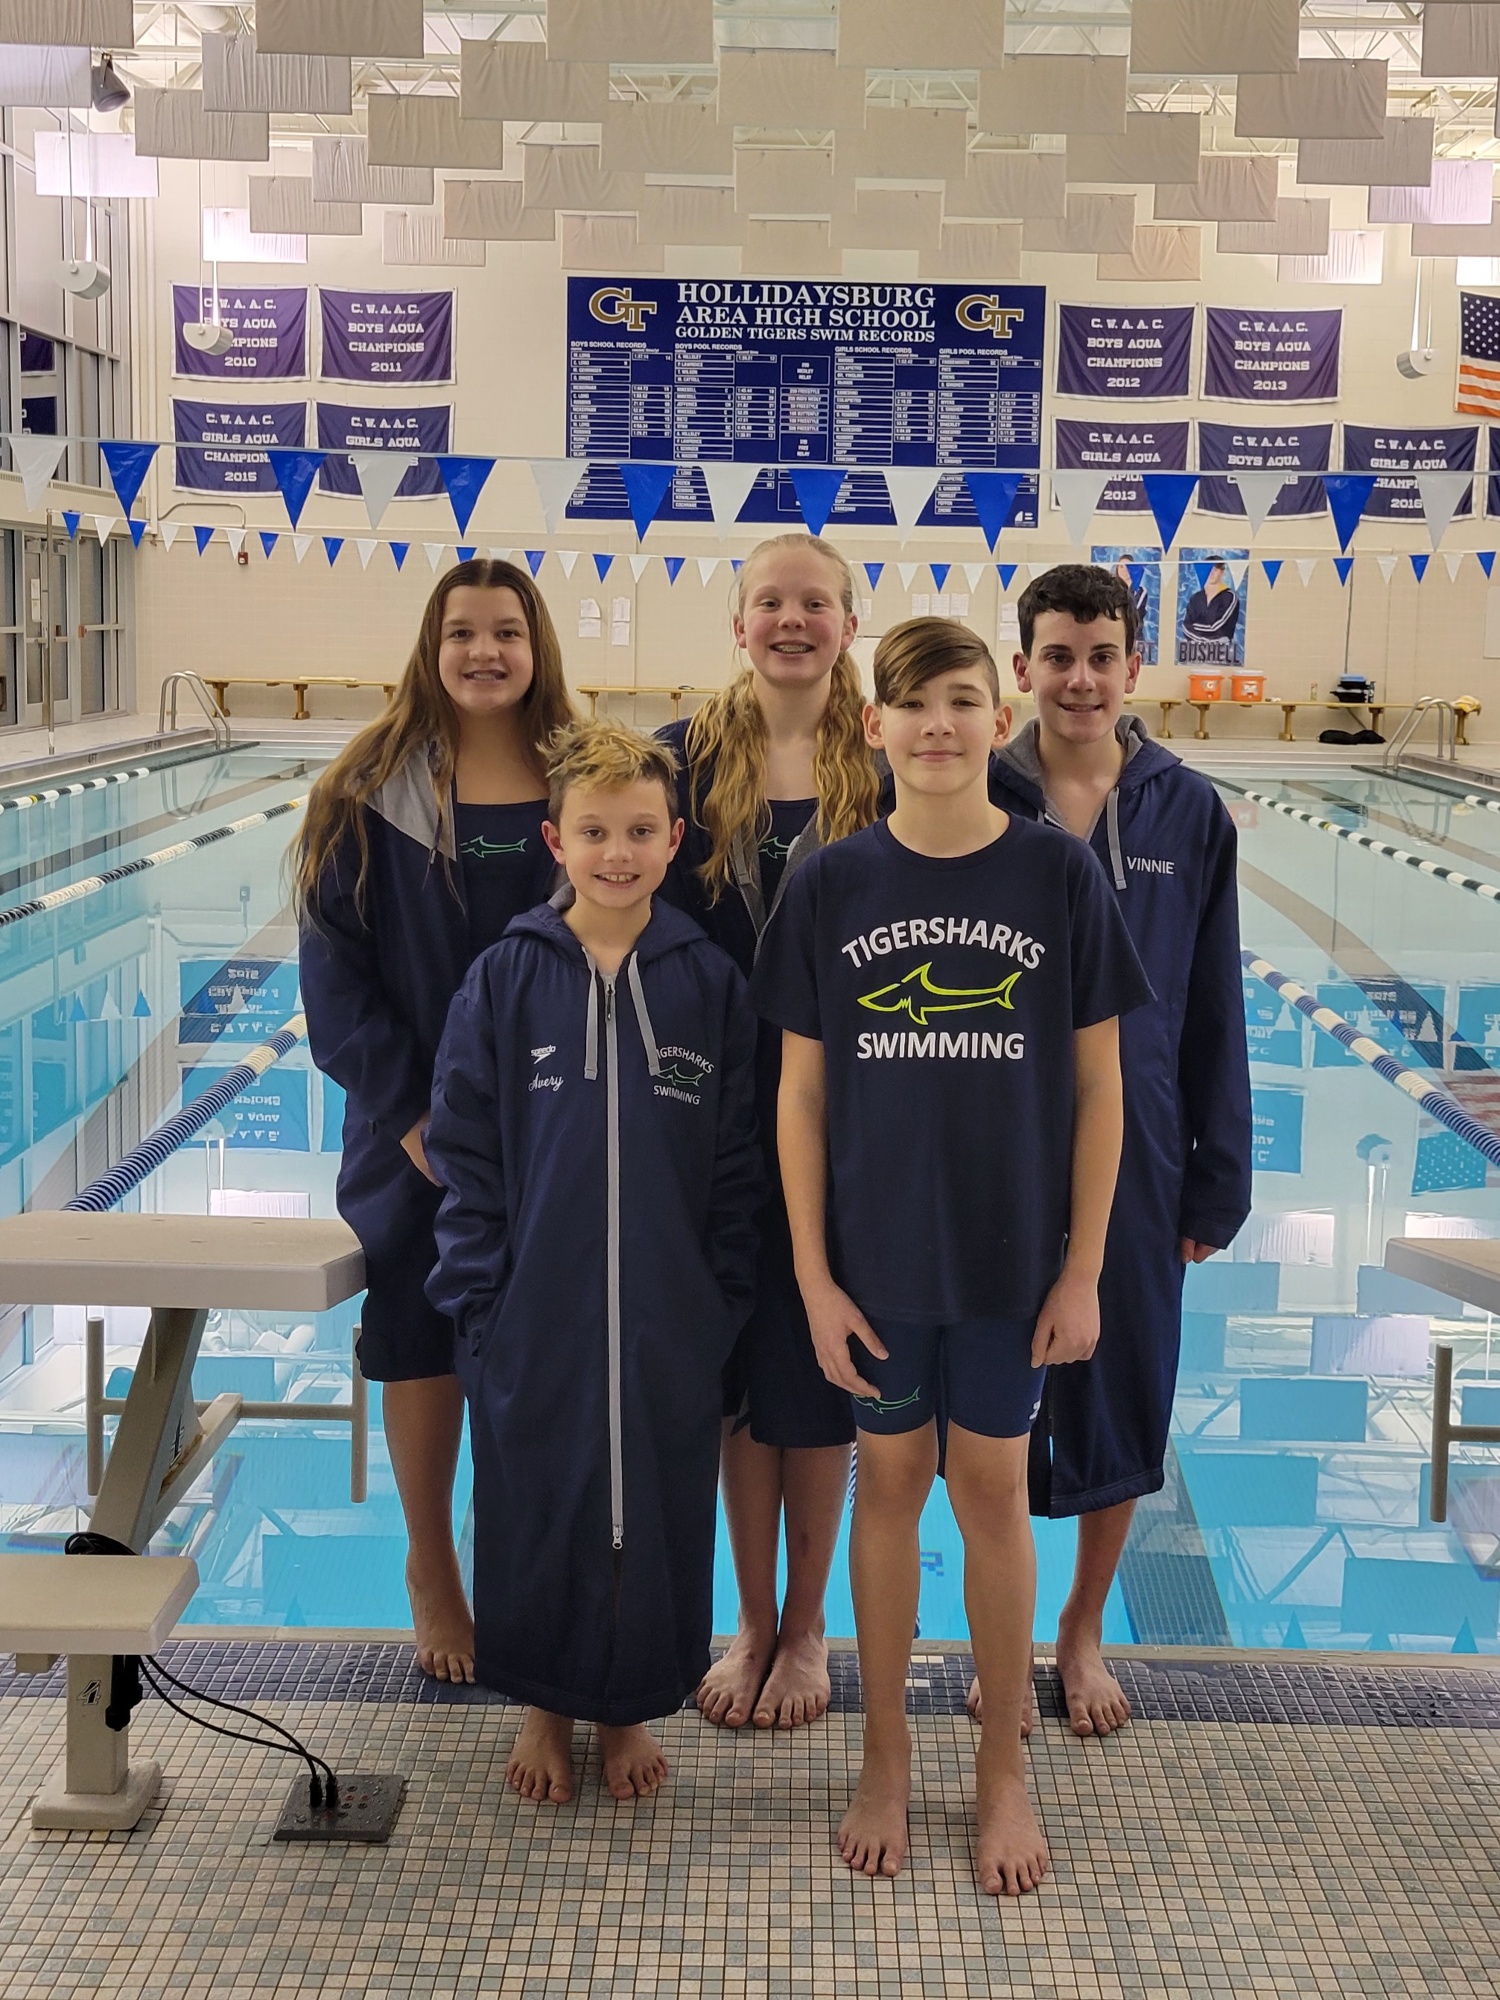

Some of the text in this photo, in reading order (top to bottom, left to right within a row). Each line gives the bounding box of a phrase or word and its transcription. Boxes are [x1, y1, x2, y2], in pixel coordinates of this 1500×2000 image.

[677, 282, 936, 308] HOLLIDAYSBURG
[204, 317, 276, 329] BYS AQUA
[676, 306, 936, 328] AREA HIGH SCHOOL
[348, 323, 424, 334] BOYS AQUA
[675, 327, 935, 342] GOLDEN TIGERS SWIM RECORDS
[349, 342, 424, 352] CHAMPIONS
[1087, 338, 1162, 349] BOYS AQUA
[1234, 340, 1311, 352] BOYS AQUA
[225, 357, 256, 367] 2010
[371, 362, 402, 372] 2011
[1087, 357, 1163, 368] CHAMPIONS
[1234, 360, 1310, 371] CHAMPIONS
[1107, 378, 1140, 387] 2012
[1253, 381, 1287, 390] 2013
[202, 432, 279, 444] GIRLS AQUA
[346, 435, 421, 447] GIRLS AQUA
[204, 451, 270, 463] CHAMPION
[1081, 451, 1161, 463] GIRLS AQUA
[1227, 455, 1300, 466] BOYS AQUA
[1370, 458, 1447, 470] GIRLS AQUA
[224, 472, 257, 482] 2015
[1103, 491, 1136, 500] 2013
[1390, 499, 1423, 508] 2016
[1178, 640, 1240, 664] BUSHELL
[1126, 856, 1174, 875] VINNIE
[842, 917, 1045, 969] TIGERSHARKS
[857, 1032, 1024, 1059] SWIMMING
[656, 1046, 714, 1074] IGERSHARKS
[528, 1072, 564, 1092] Avery
[654, 1084, 701, 1106] SWIMMING
[77, 1680, 102, 1705] 4
